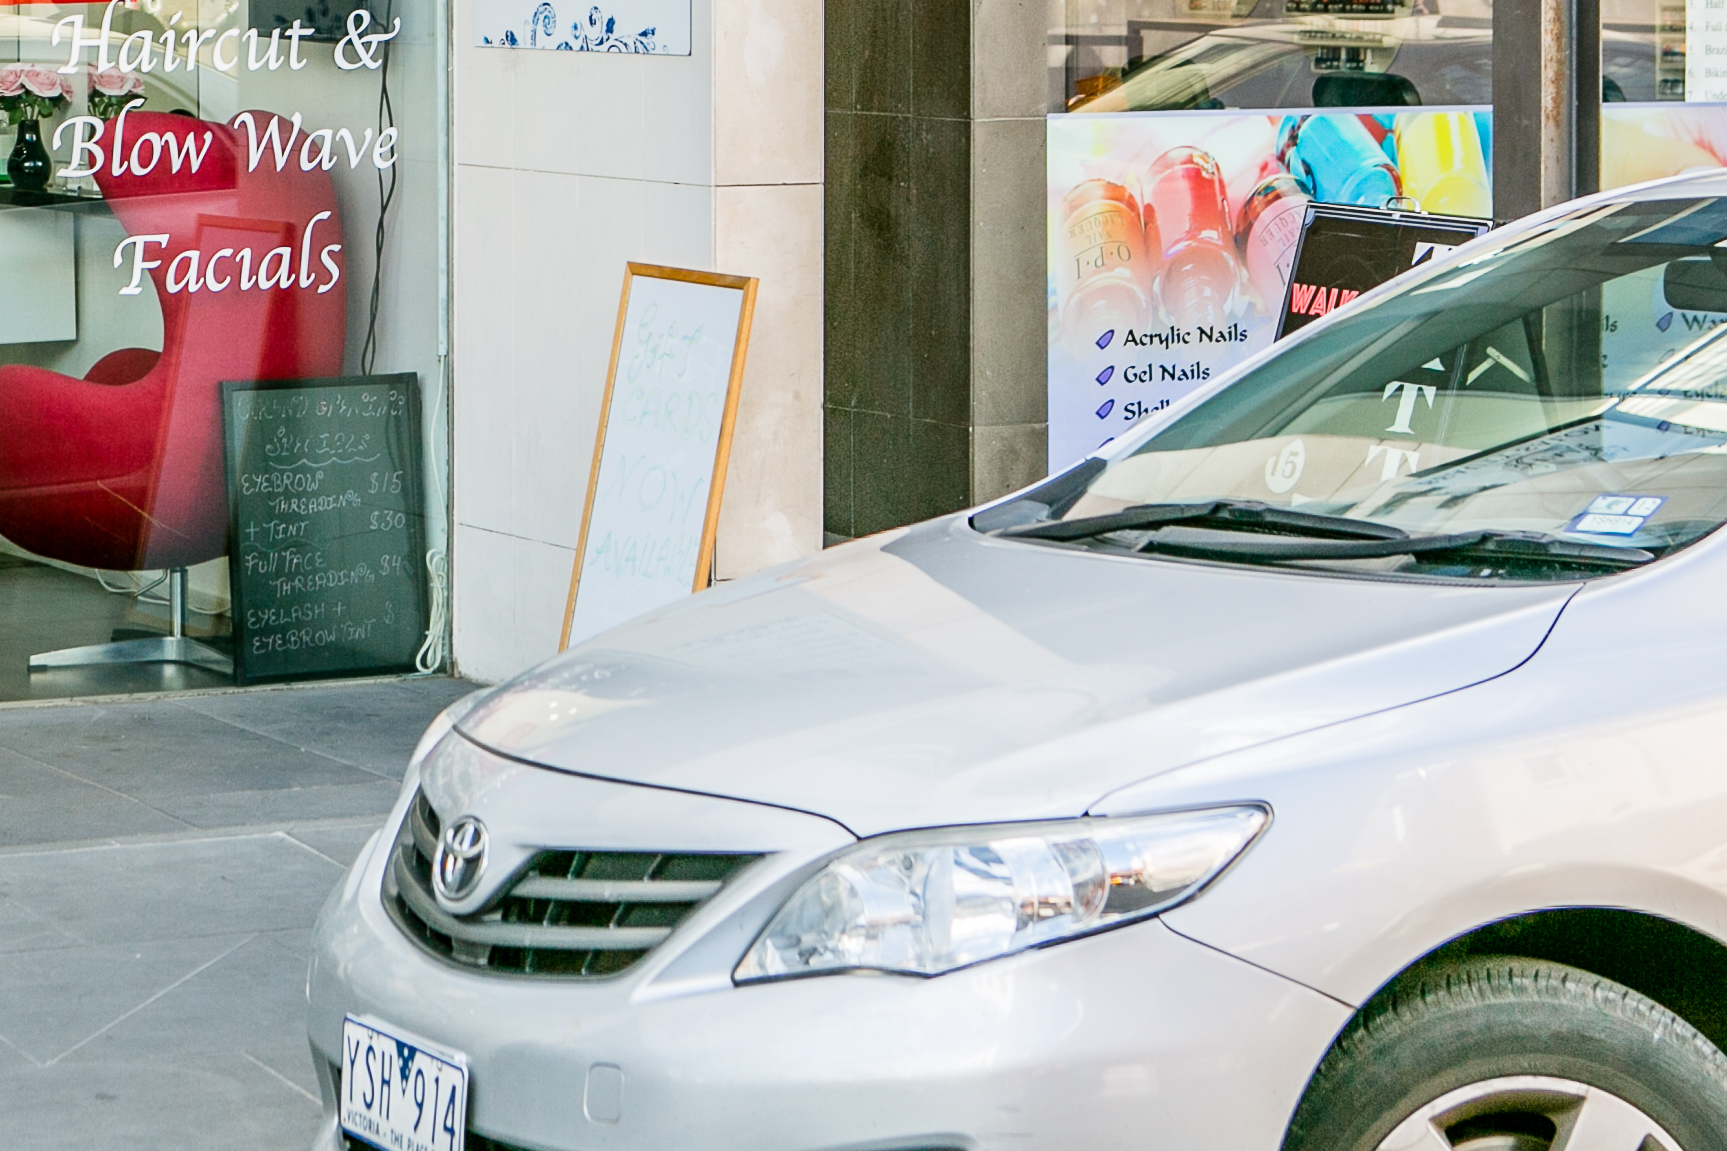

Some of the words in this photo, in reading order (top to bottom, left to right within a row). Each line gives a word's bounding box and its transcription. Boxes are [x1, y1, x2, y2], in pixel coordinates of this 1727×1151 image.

[333, 8, 401, 70] &
[52, 98, 213, 179] Blow
[233, 110, 399, 175] Wave
[113, 209, 343, 296] Facials
[1123, 325, 1190, 350] Acrylic
[1198, 322, 1248, 343] Nails
[1123, 362, 1153, 384] Gel
[1159, 361, 1210, 382] Nails
[621, 384, 719, 443] CARDS
[242, 471, 324, 494] EYEBROW
[368, 471, 403, 494] $15
[604, 454, 704, 528] NOW
[263, 521, 309, 542] TINT
[370, 510, 405, 531] $30
[281, 549, 326, 572] FACE
[247, 604, 325, 629] EYELASH
[253, 628, 335, 654] EYEBROW
[347, 1034, 393, 1121] YSH
[413, 1067, 457, 1151] 914
[346, 1108, 381, 1136] VICTORIA
